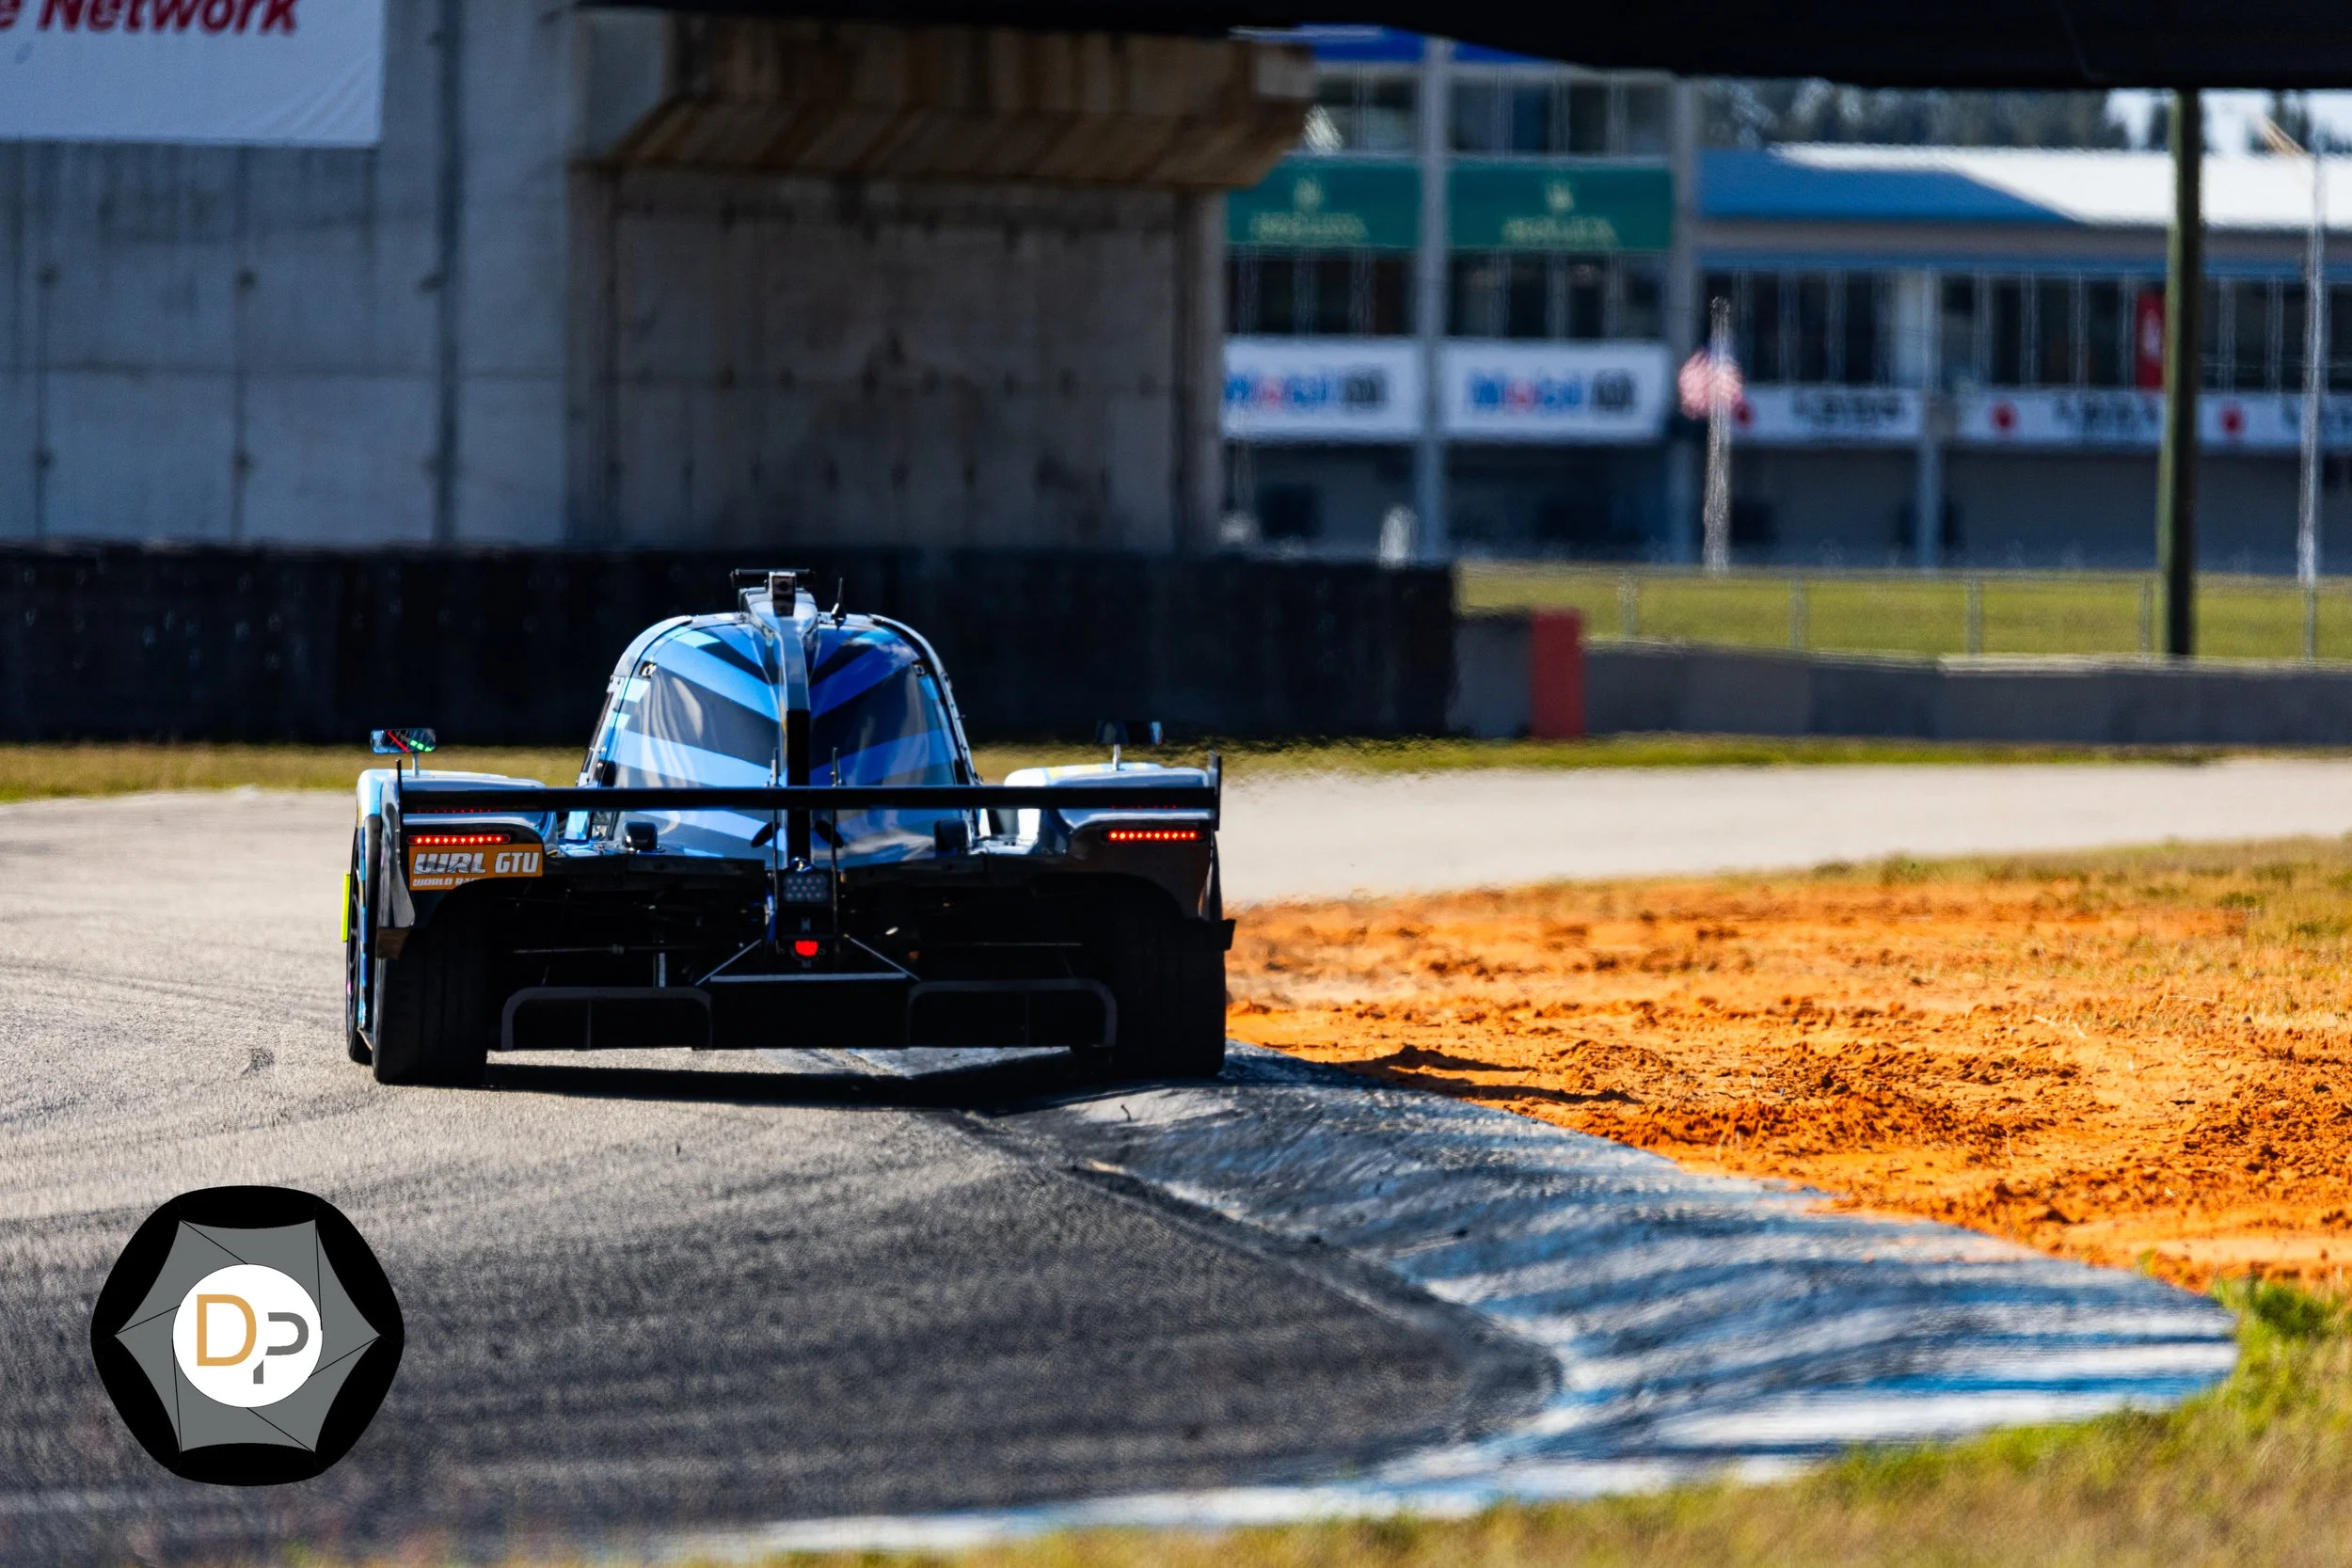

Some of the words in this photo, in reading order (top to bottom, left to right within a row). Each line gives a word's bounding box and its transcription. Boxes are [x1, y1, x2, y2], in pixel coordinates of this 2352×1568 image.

[36, 0, 298, 36] Network
[413, 852, 486, 875] WRL
[495, 852, 539, 873] GTU
[413, 878, 453, 886] WORLD
